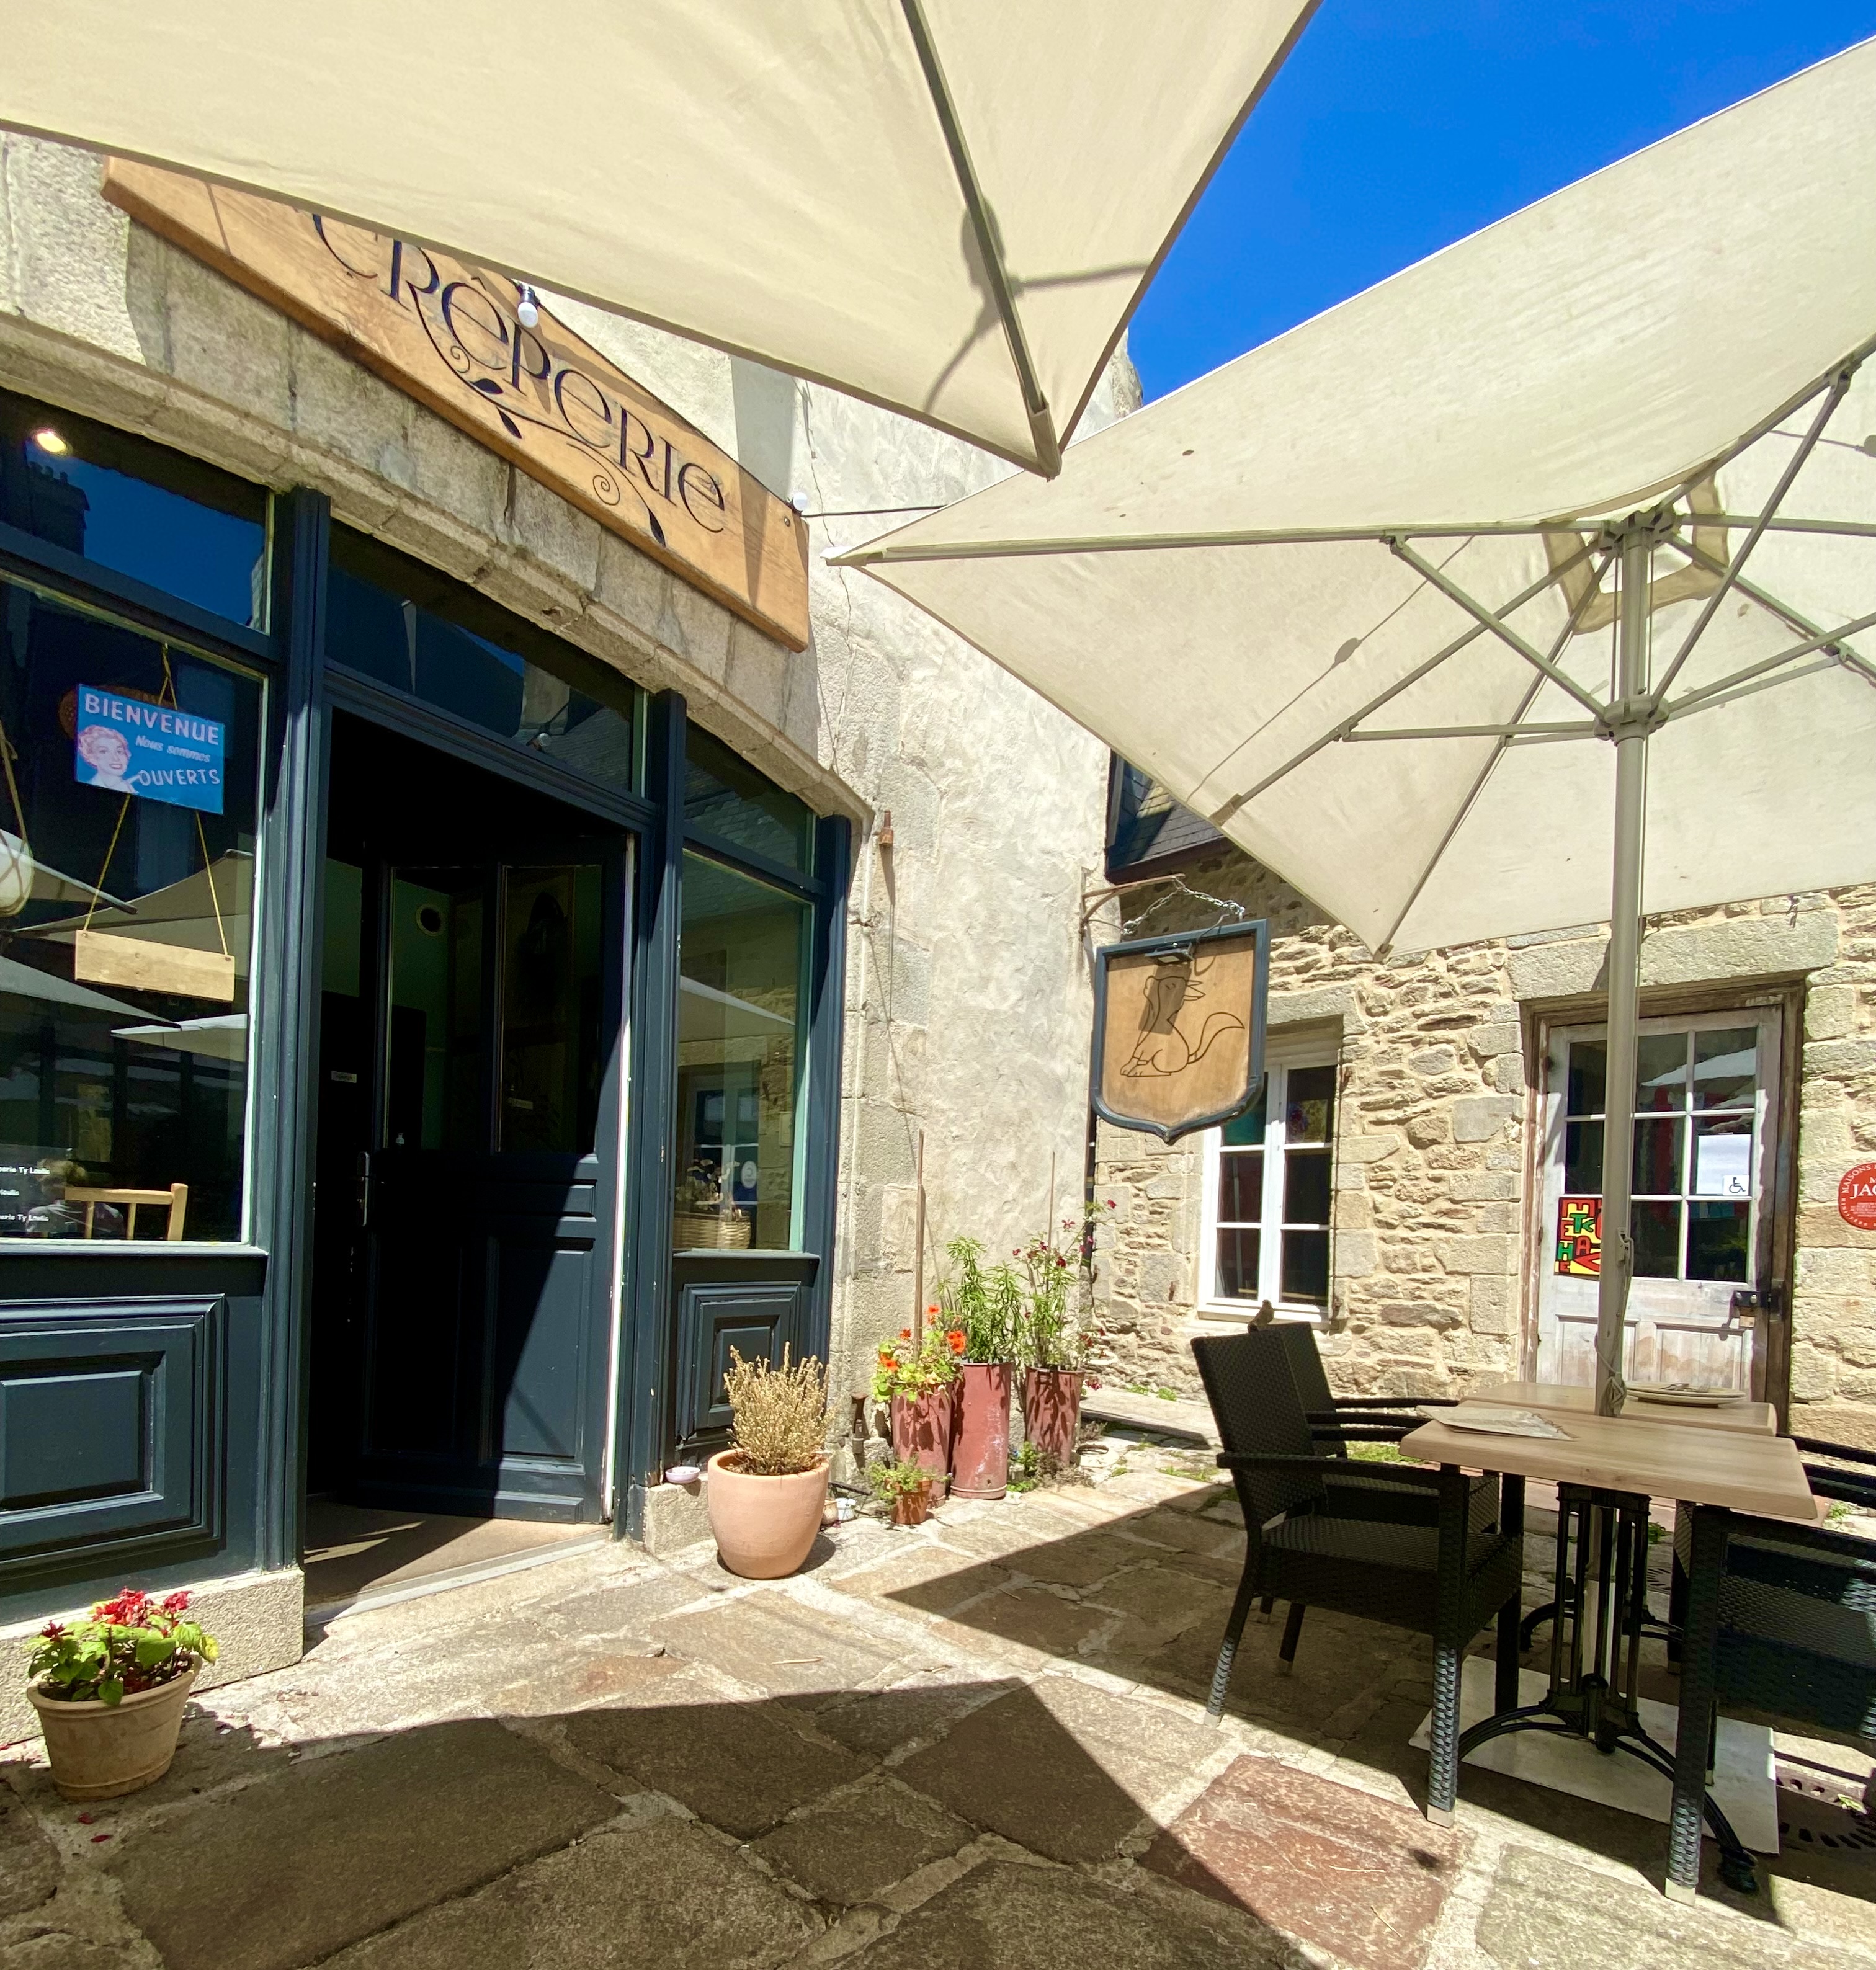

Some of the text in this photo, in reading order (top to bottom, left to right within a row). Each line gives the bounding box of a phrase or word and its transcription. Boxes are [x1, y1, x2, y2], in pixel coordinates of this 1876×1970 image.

[85, 693, 219, 746] BIENVENUE
[136, 735, 211, 763] Nous sommes
[138, 769, 220, 787] OUVERTS
[1841, 1164, 1872, 1193] MAISONS
